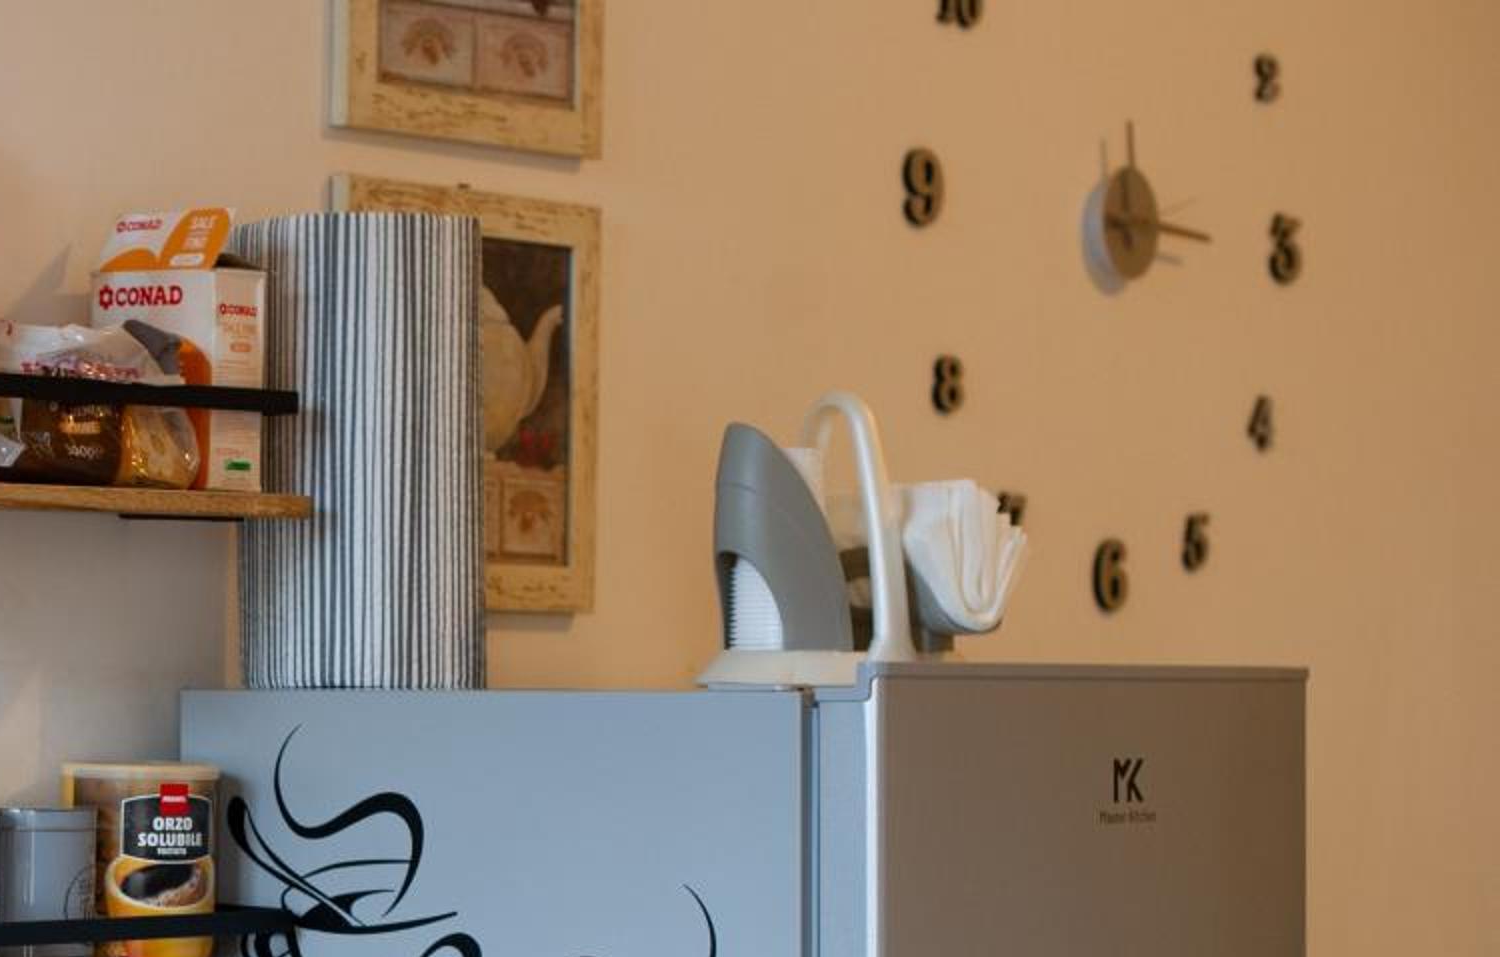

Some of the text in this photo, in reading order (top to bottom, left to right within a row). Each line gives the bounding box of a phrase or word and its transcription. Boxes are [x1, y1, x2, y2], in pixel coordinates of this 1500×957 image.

[1253, 53, 1280, 104] 2
[902, 146, 944, 230] 9
[1268, 212, 1302, 286] 3
[115, 284, 183, 307] CONAD
[931, 354, 964, 416] 8
[1247, 395, 1274, 454] 4
[1182, 512, 1209, 574] 5
[1092, 538, 1129, 614] 6
[137, 832, 203, 848] SOLUBILE
[152, 816, 193, 831] ORZO
